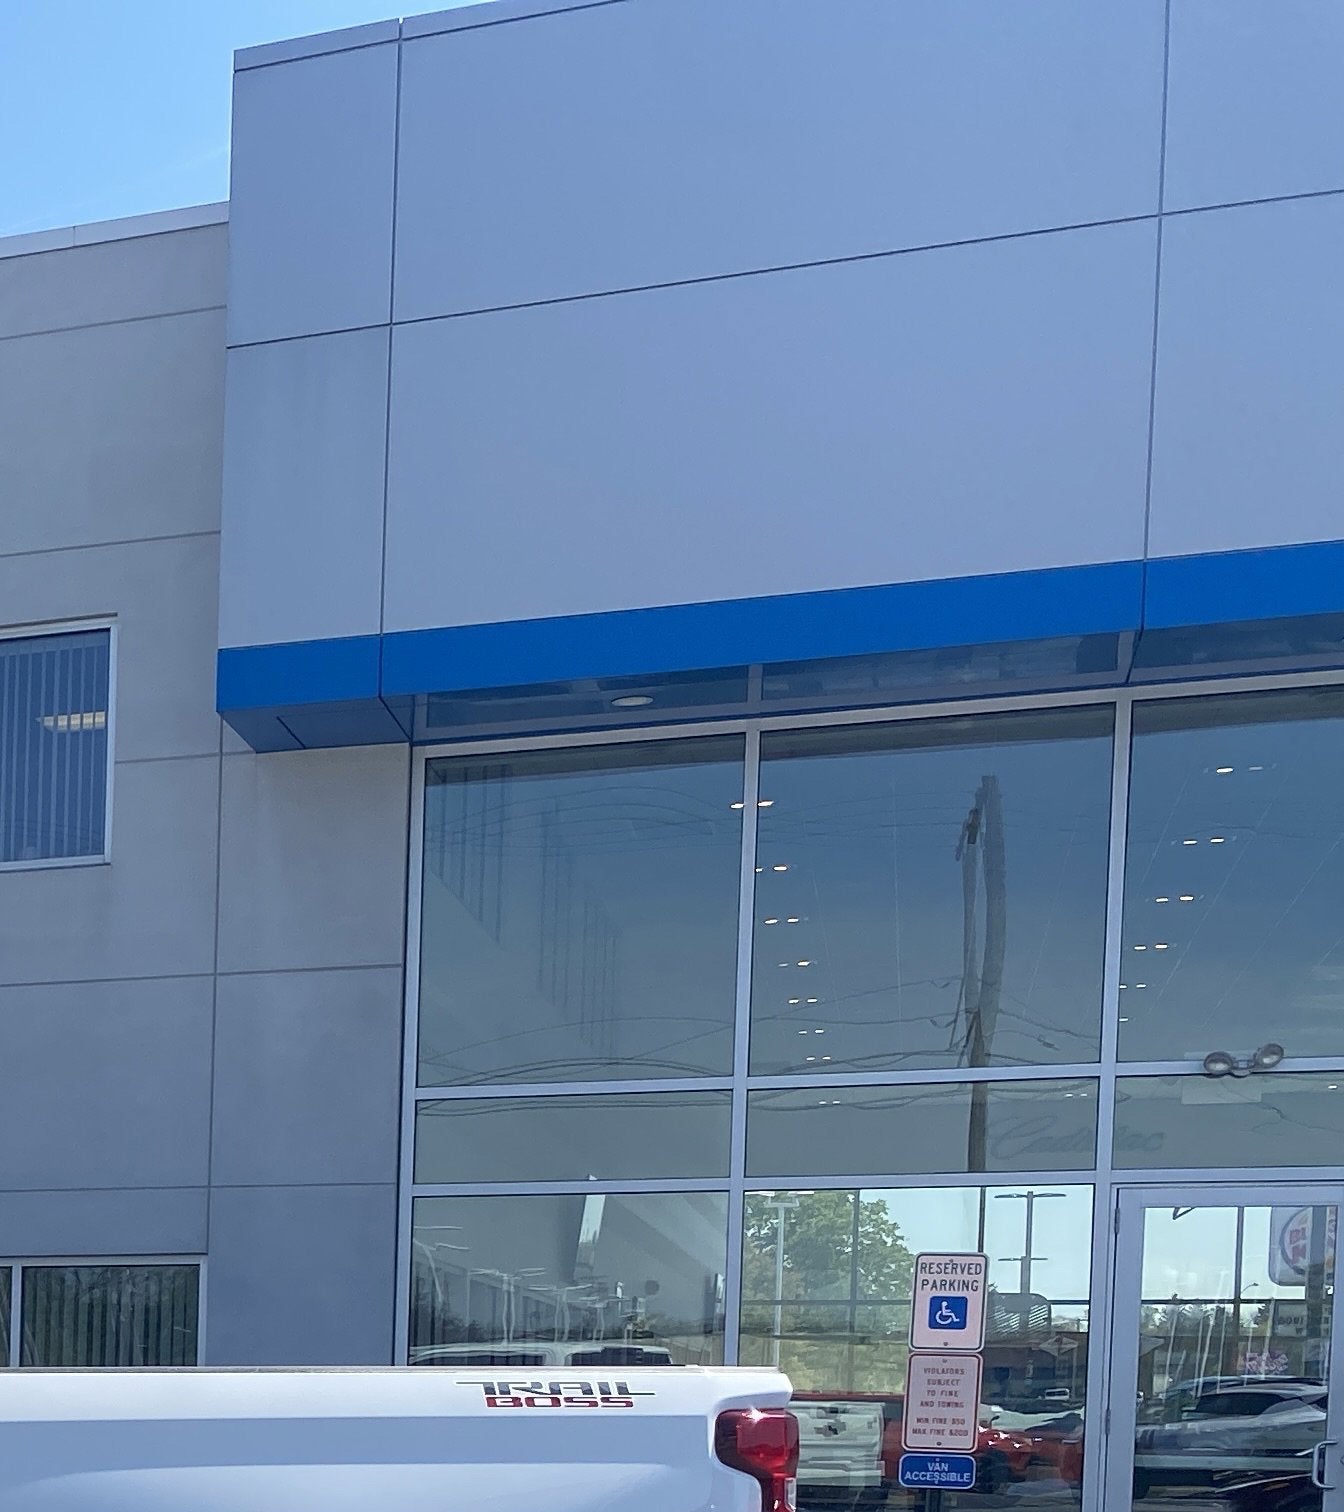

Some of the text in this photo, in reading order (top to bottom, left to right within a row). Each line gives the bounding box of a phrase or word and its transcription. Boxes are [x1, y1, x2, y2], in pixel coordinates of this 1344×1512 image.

[919, 1262, 983, 1275] RESERVED
[921, 1279, 979, 1292] PARKING
[923, 1367, 965, 1375] VIOLATORS
[927, 1378, 960, 1386] SUBJECT
[455, 1381, 656, 1396] TRAIL
[927, 1389, 959, 1398] TO FINE
[485, 1396, 634, 1408] BOSS
[919, 1400, 935, 1408] AND
[927, 1462, 949, 1472] VAN
[903, 1471, 972, 1483] ACCESSIBLE
